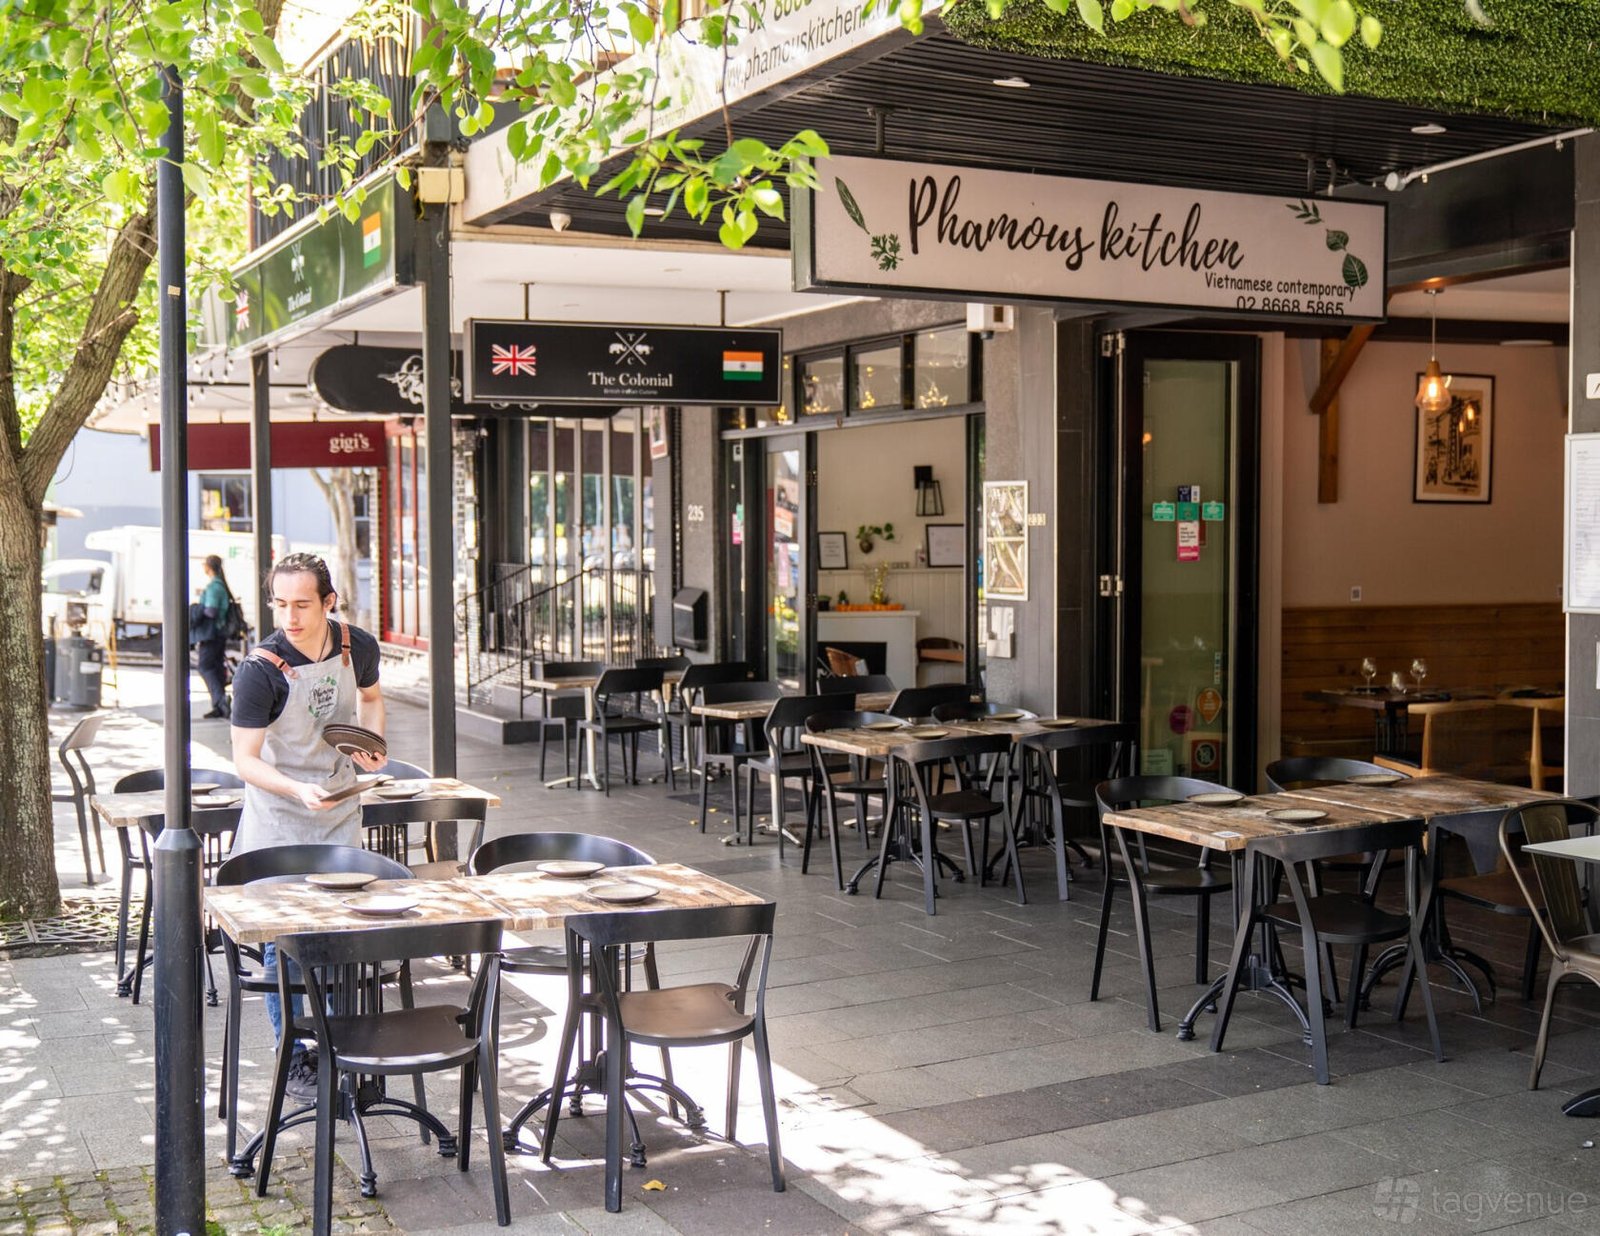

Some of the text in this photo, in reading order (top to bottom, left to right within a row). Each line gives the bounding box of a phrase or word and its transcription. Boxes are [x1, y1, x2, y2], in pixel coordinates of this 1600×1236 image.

[908, 175, 1245, 272] Phamous kitchen
[1205, 272, 1355, 302] Vietnamese contemporary
[1236, 296, 1344, 316] 02 8668 5865
[588, 371, 673, 387] The Colonial
[329, 432, 370, 454] gigi's
